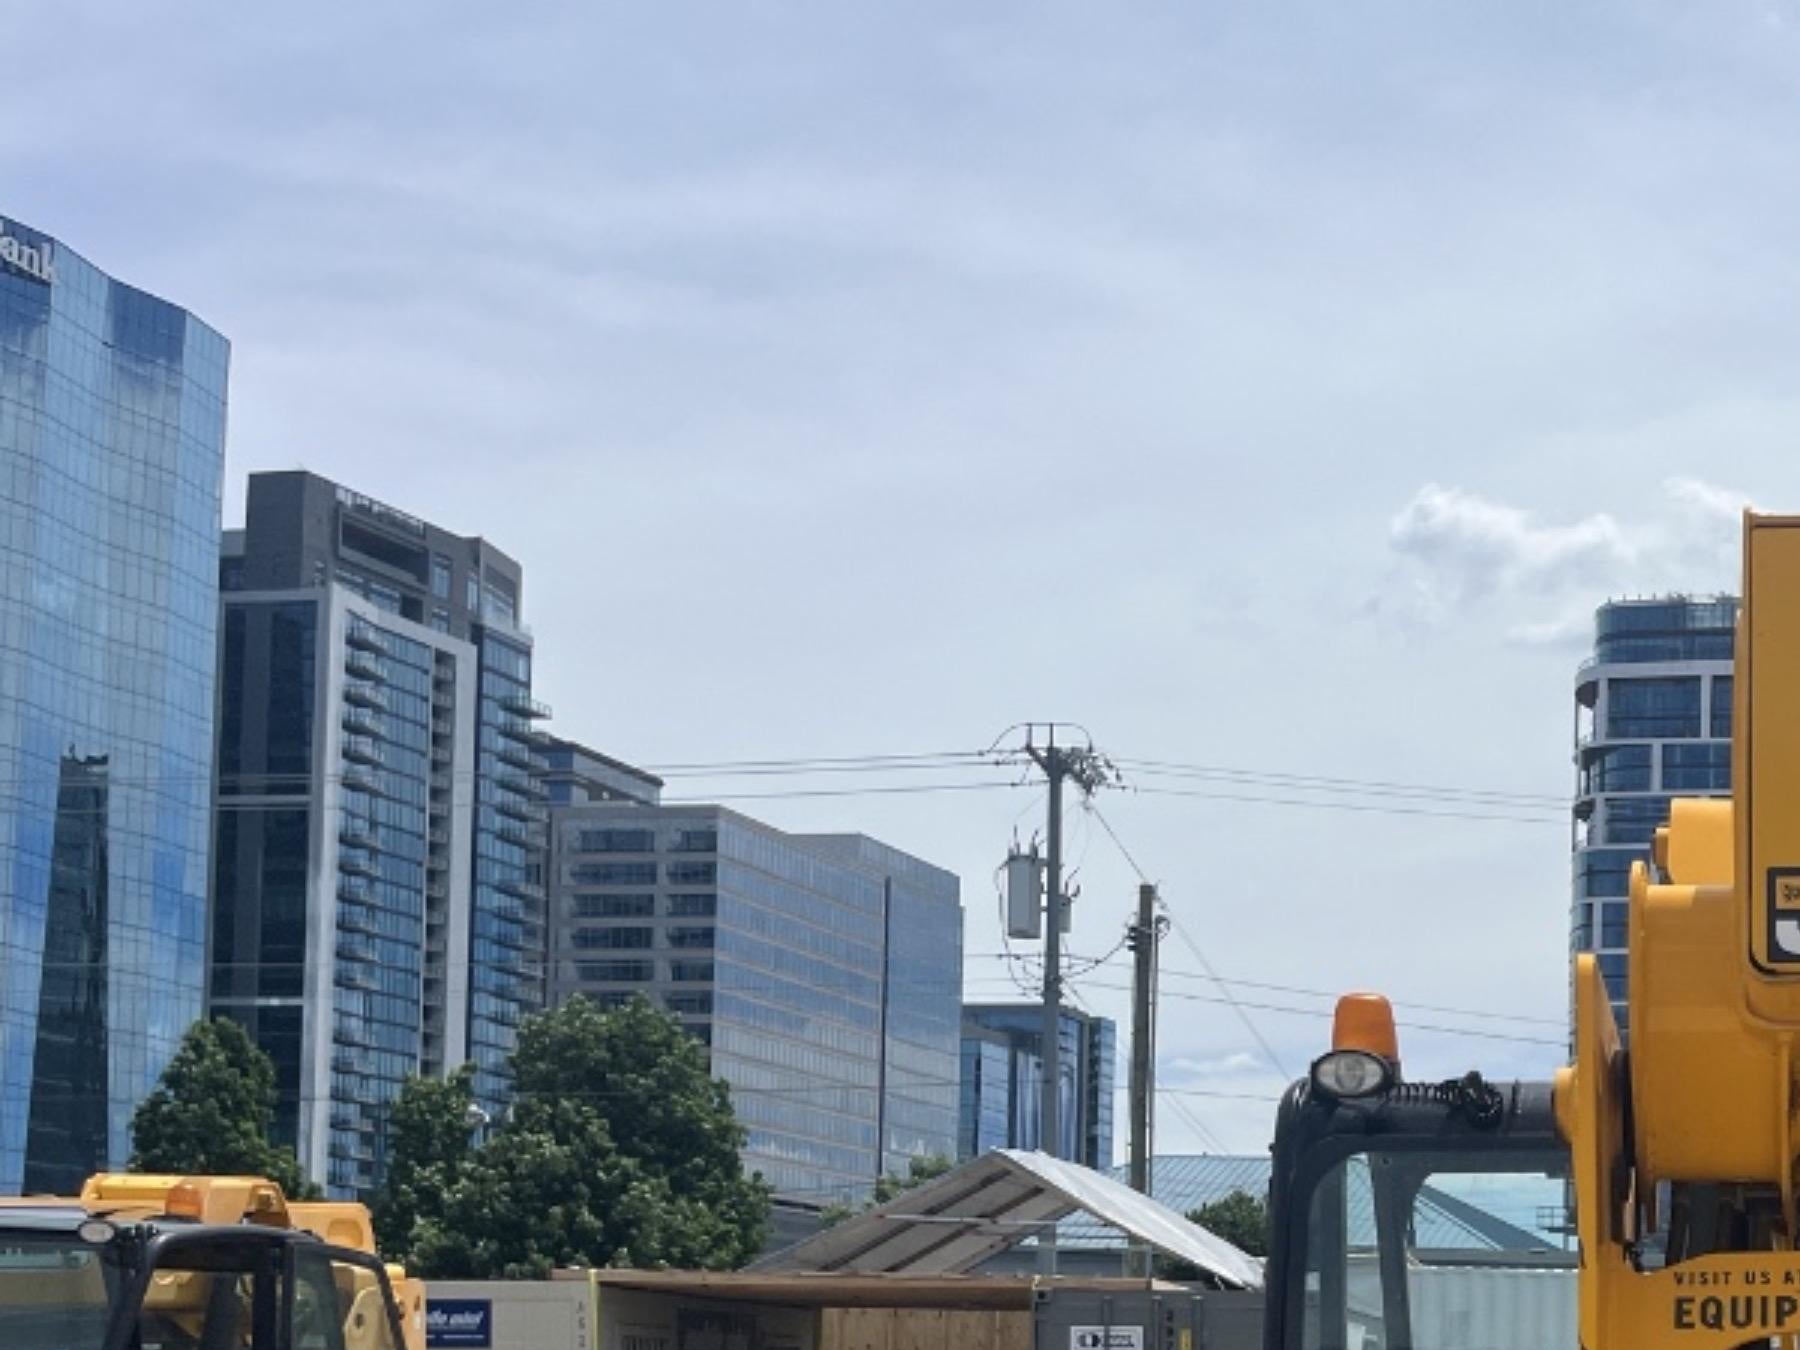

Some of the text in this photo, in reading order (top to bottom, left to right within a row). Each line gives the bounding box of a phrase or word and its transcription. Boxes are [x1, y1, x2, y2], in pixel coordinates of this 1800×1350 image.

[0, 219, 56, 283] ank
[1673, 1271, 1732, 1285] VISIT
[1745, 1270, 1771, 1285] US
